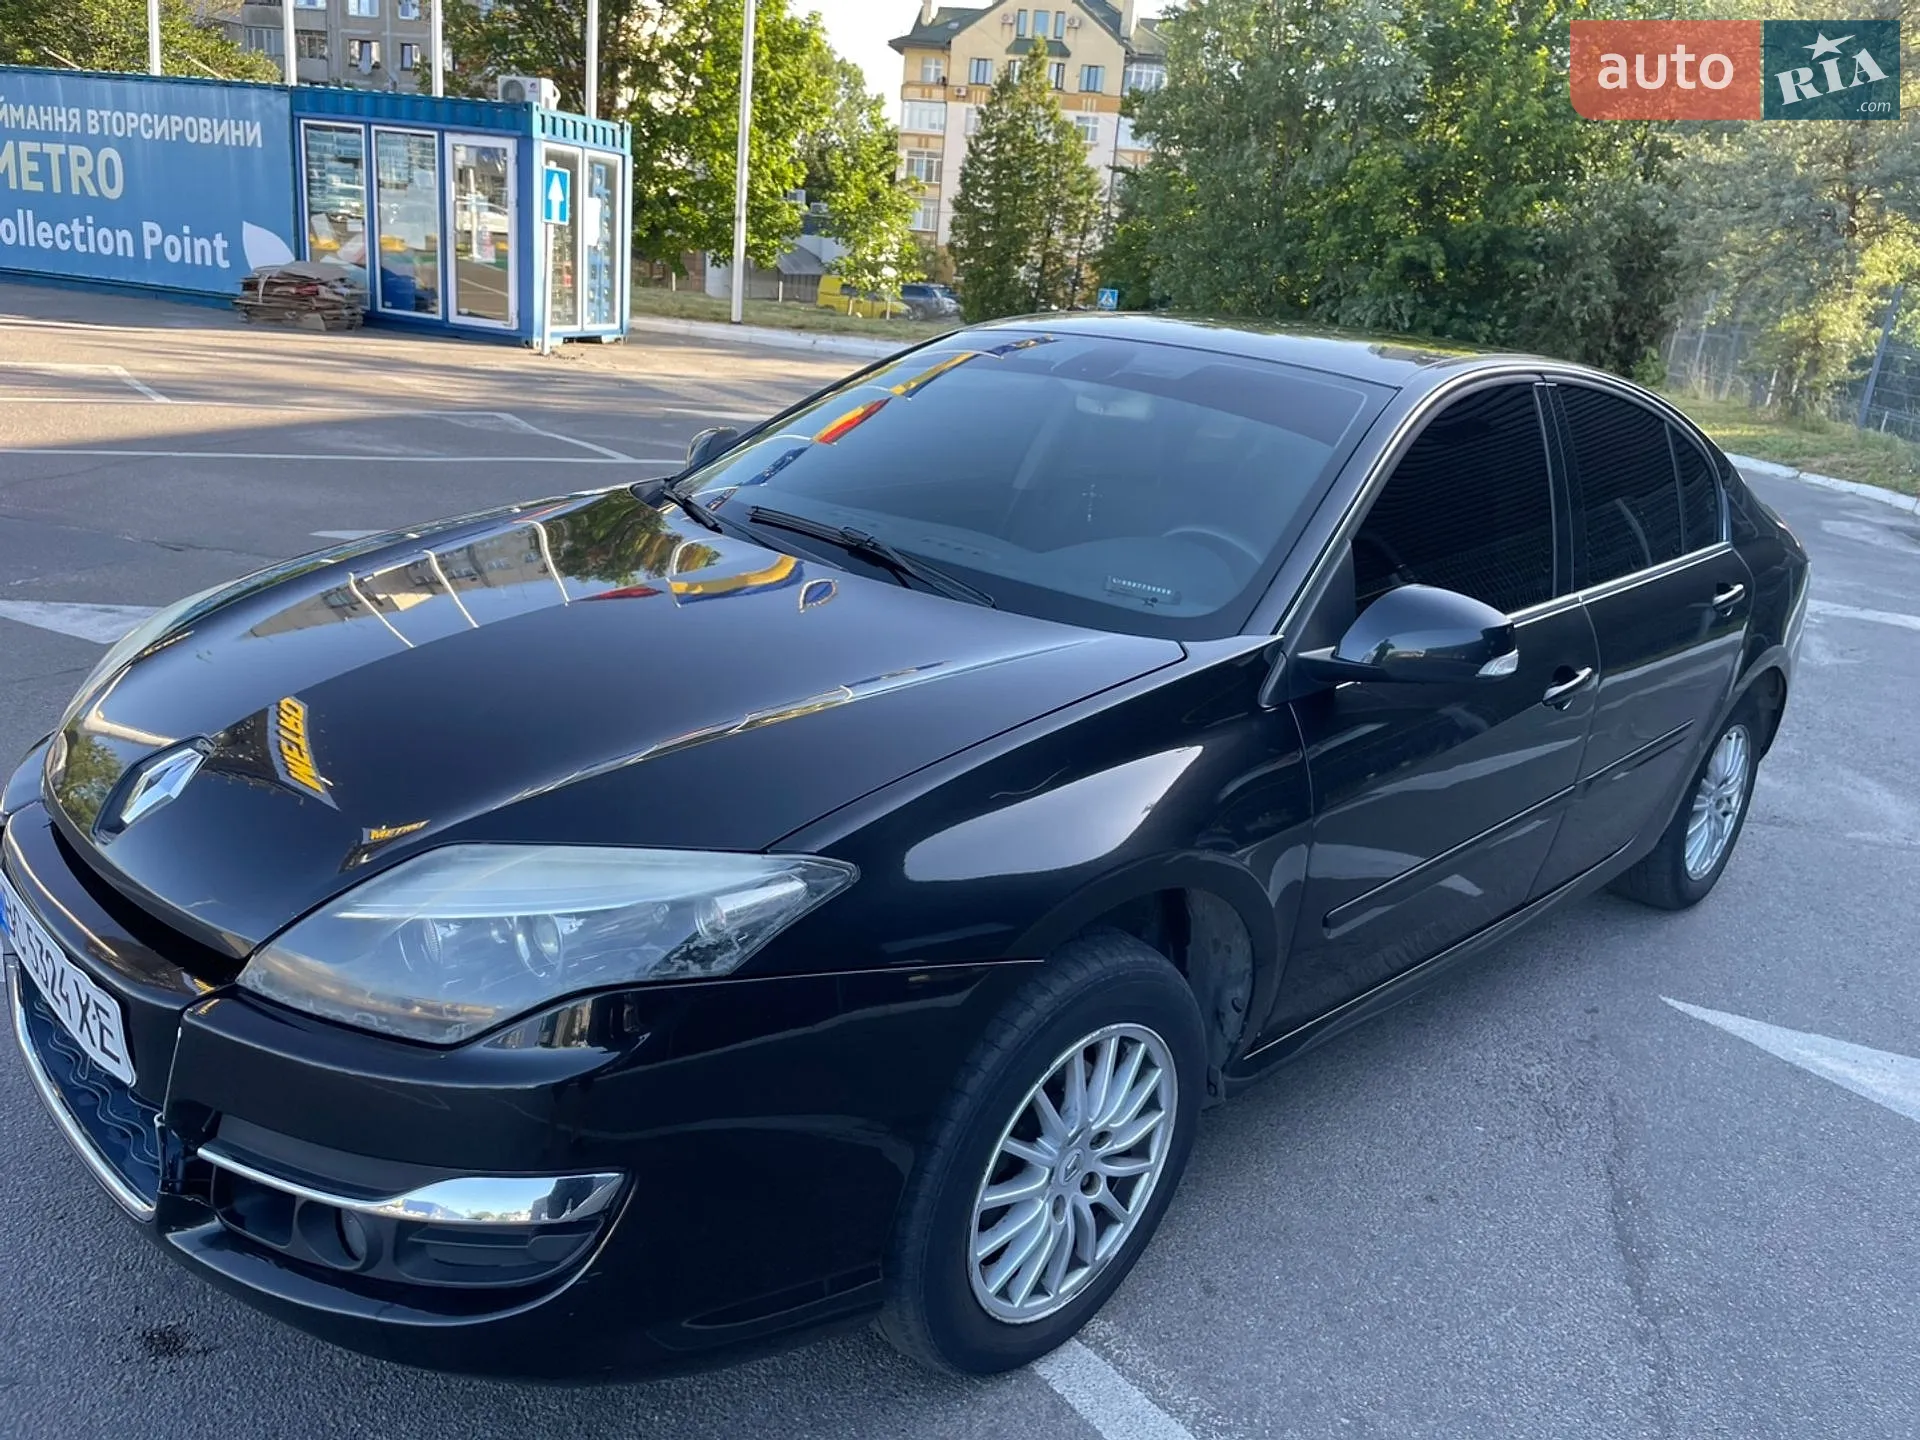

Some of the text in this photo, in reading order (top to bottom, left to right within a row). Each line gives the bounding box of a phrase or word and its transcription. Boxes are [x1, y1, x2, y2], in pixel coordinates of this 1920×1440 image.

[87, 109, 263, 148] ВТОРСИРОВИНИ
[142, 221, 231, 269] Point
[25, 920, 73, 1021] 5324
[73, 978, 121, 1066] XE
